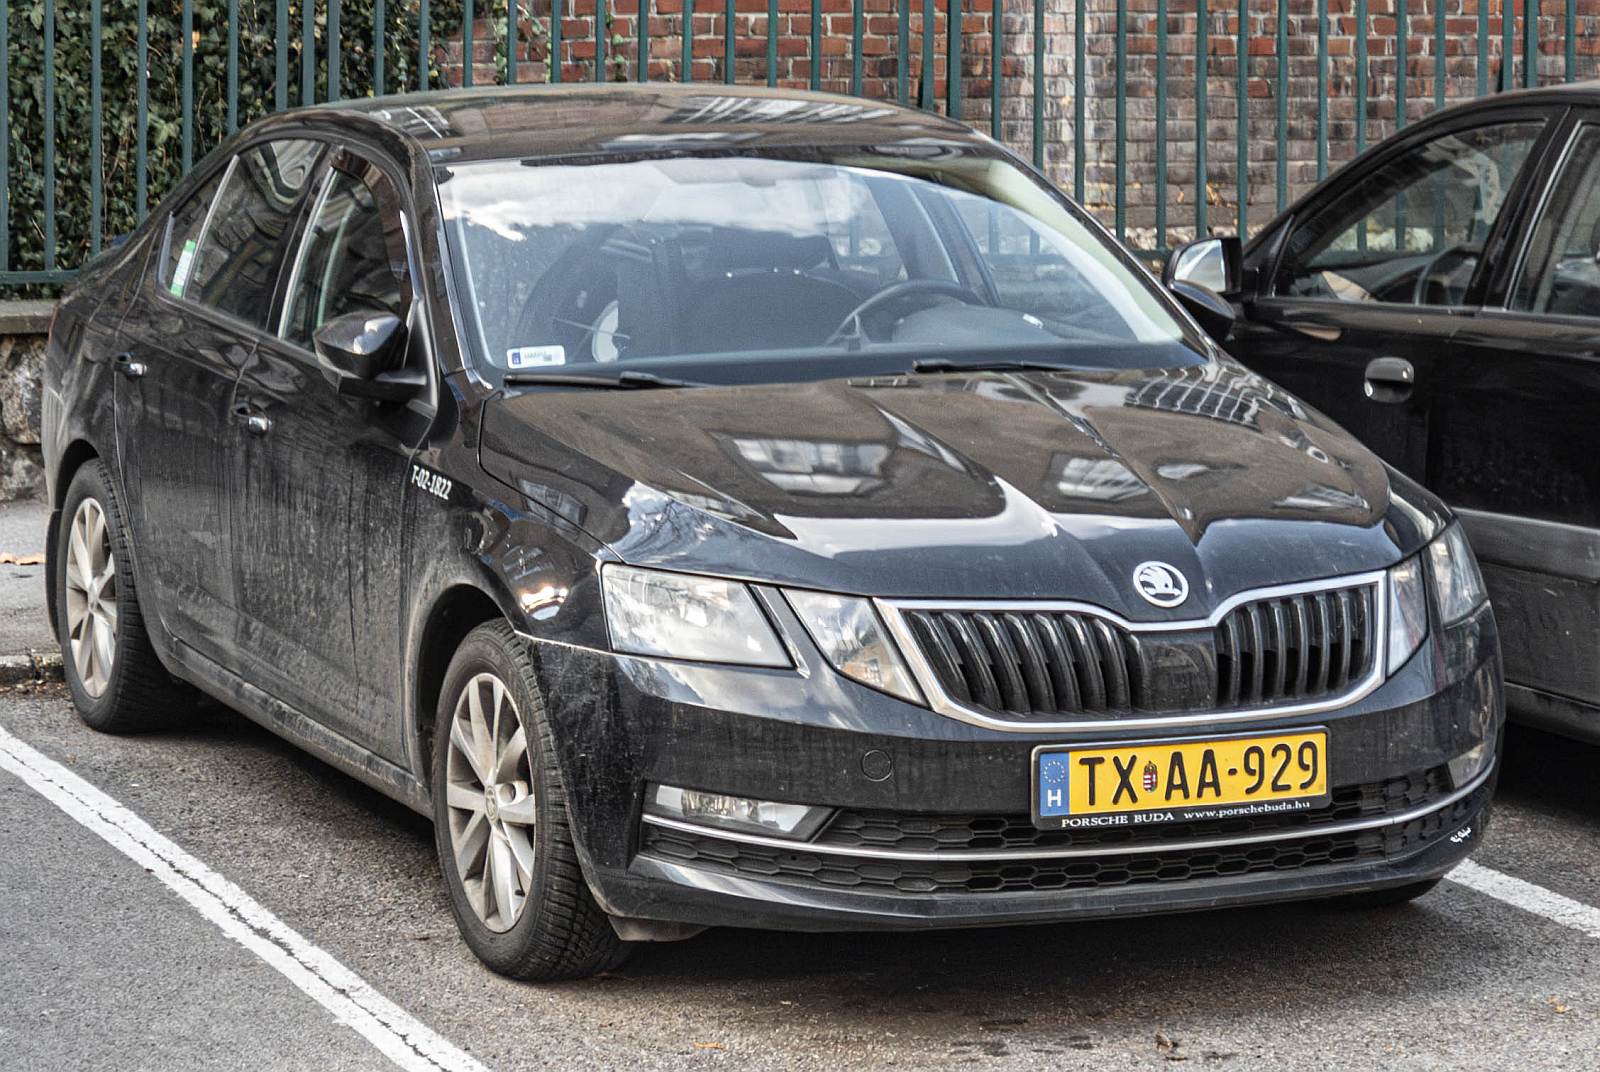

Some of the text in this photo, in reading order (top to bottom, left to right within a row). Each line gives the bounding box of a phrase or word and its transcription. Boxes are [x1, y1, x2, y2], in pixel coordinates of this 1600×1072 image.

[411, 464, 452, 500] T-02-1822
[1079, 741, 1318, 806] TX AA-929
[1047, 789, 1062, 807] H
[1061, 800, 1311, 828] PORSCHE BUDA www.porschebuda.hu
